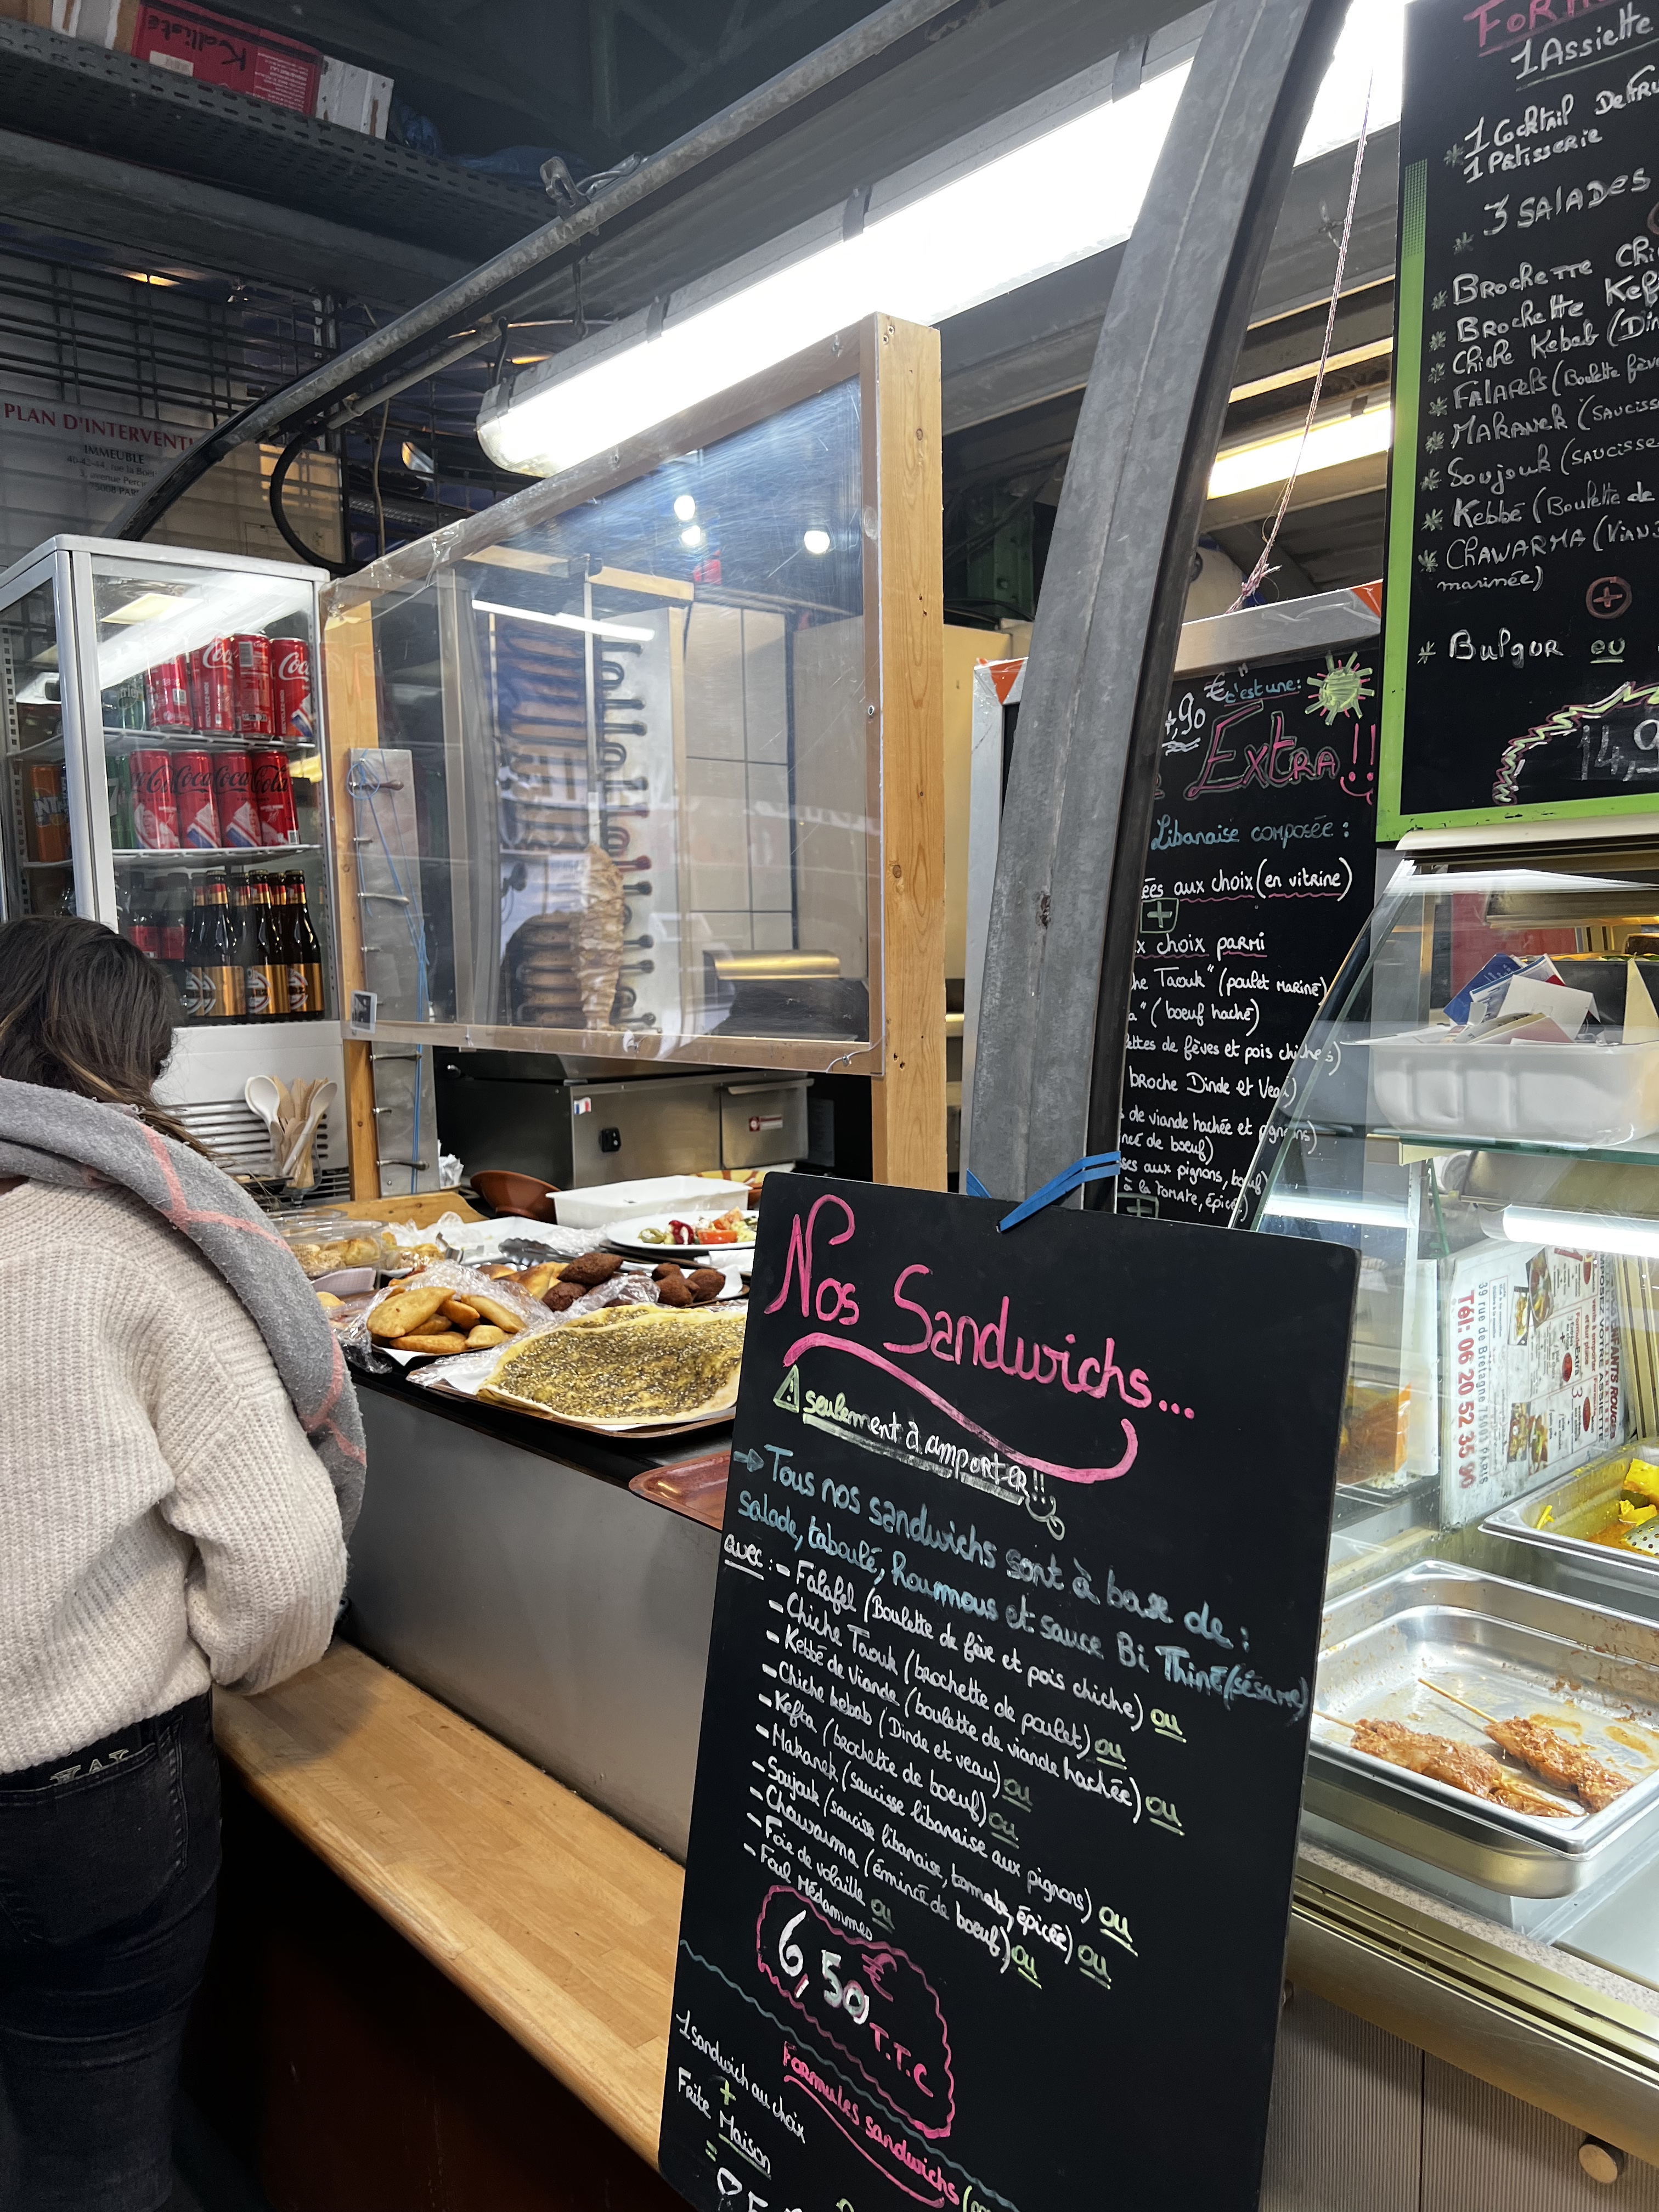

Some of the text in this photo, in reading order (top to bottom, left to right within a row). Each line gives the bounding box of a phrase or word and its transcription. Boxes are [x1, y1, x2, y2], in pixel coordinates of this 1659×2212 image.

[1510, 2, 1654, 80] 1 Assiette
[1464, 93, 1574, 160] 1 Cocktail
[1464, 156, 1483, 184] 1
[1483, 194, 1510, 236] 3
[1453, 338, 1514, 374] Chiche
[4, 403, 55, 426] PLAN
[84, 445, 144, 465] IMMEUBLE
[1627, 482, 1655, 502] de
[1590, 637, 1625, 654] ou
[1225, 678, 1264, 703] c'est
[1175, 881, 1204, 895] aux
[1211, 869, 1254, 893] choix
[1156, 933, 1206, 955] choix
[1218, 968, 1269, 997] (poulet
[1211, 999, 1260, 1037] haché)
[1162, 1036, 1273, 1064] de fèves et pois
[1187, 1072, 1231, 1094] Dinde
[1237, 1077, 1254, 1096] et
[1130, 1104, 1253, 1136] de viande hachée et
[1147, 1133, 1163, 1150] de
[1124, 1177, 1151, 1194] à la
[1144, 1160, 1228, 1190] aux pignons,
[764, 1194, 1195, 1420] Nos Sandwichs...
[1458, 1339, 1475, 1365] 06
[1476, 1283, 1488, 1402] 39 rue de Bretagne
[1458, 1368, 1475, 1396] 20
[805, 1391, 901, 1443] seulement
[906, 1420, 924, 1455] à
[1458, 1401, 1475, 1429] 52
[764, 1444, 815, 1498] Tous
[822, 1478, 860, 1515] nos
[869, 1496, 997, 1568] sandwichs
[1006, 1549, 1065, 1590] sont
[1073, 1558, 1101, 1605] à
[1184, 1601, 1234, 1650] de
[738, 1490, 803, 1553] salade,
[808, 1516, 885, 1585] taboulé,
[1006, 1595, 1036, 1634] et
[1040, 1615, 1104, 1661] sauce
[1116, 1631, 1149, 1673] Bi
[797, 1560, 1182, 1735] Falafel (Boulette de fève et pois chiche) ou
[787, 1592, 842, 1647] Chiche
[847, 1624, 898, 1675] Taouk
[995, 1695, 1015, 1723] de
[1022, 1713, 1091, 1759] poulet)
[1095, 1739, 1126, 1763] ou
[779, 1661, 825, 1702] Chiche
[879, 1707, 929, 1753] (Dinde
[934, 1740, 951, 1762] et
[956, 1755, 1000, 1798] veau)
[1004, 1778, 1034, 1807] ou
[785, 1624, 1183, 1827] Kebbé de Viande (boulette de viande hachée) ou
[775, 1690, 817, 1733] Kefta
[903, 1762, 923, 1787] de
[988, 1812, 1019, 1842] ou
[761, 1844, 792, 1883] Foul
[766, 1815, 894, 1925] Foie de volaille ou
[843, 1761, 905, 1816] (saucisse
[910, 1799, 988, 1858] libanaise
[992, 1850, 1020, 1877] aux
[1028, 1867, 1092, 1924] pignons)
[1098, 1906, 1133, 1944] ou
[930, 1898, 950, 1921] de
[1011, 1945, 1038, 1979] ou
[1077, 1945, 1112, 1983] ou
[678, 2067, 711, 2119] Frite
[752, 2083, 806, 2144] au choix
[719, 2109, 771, 2174] Maison
